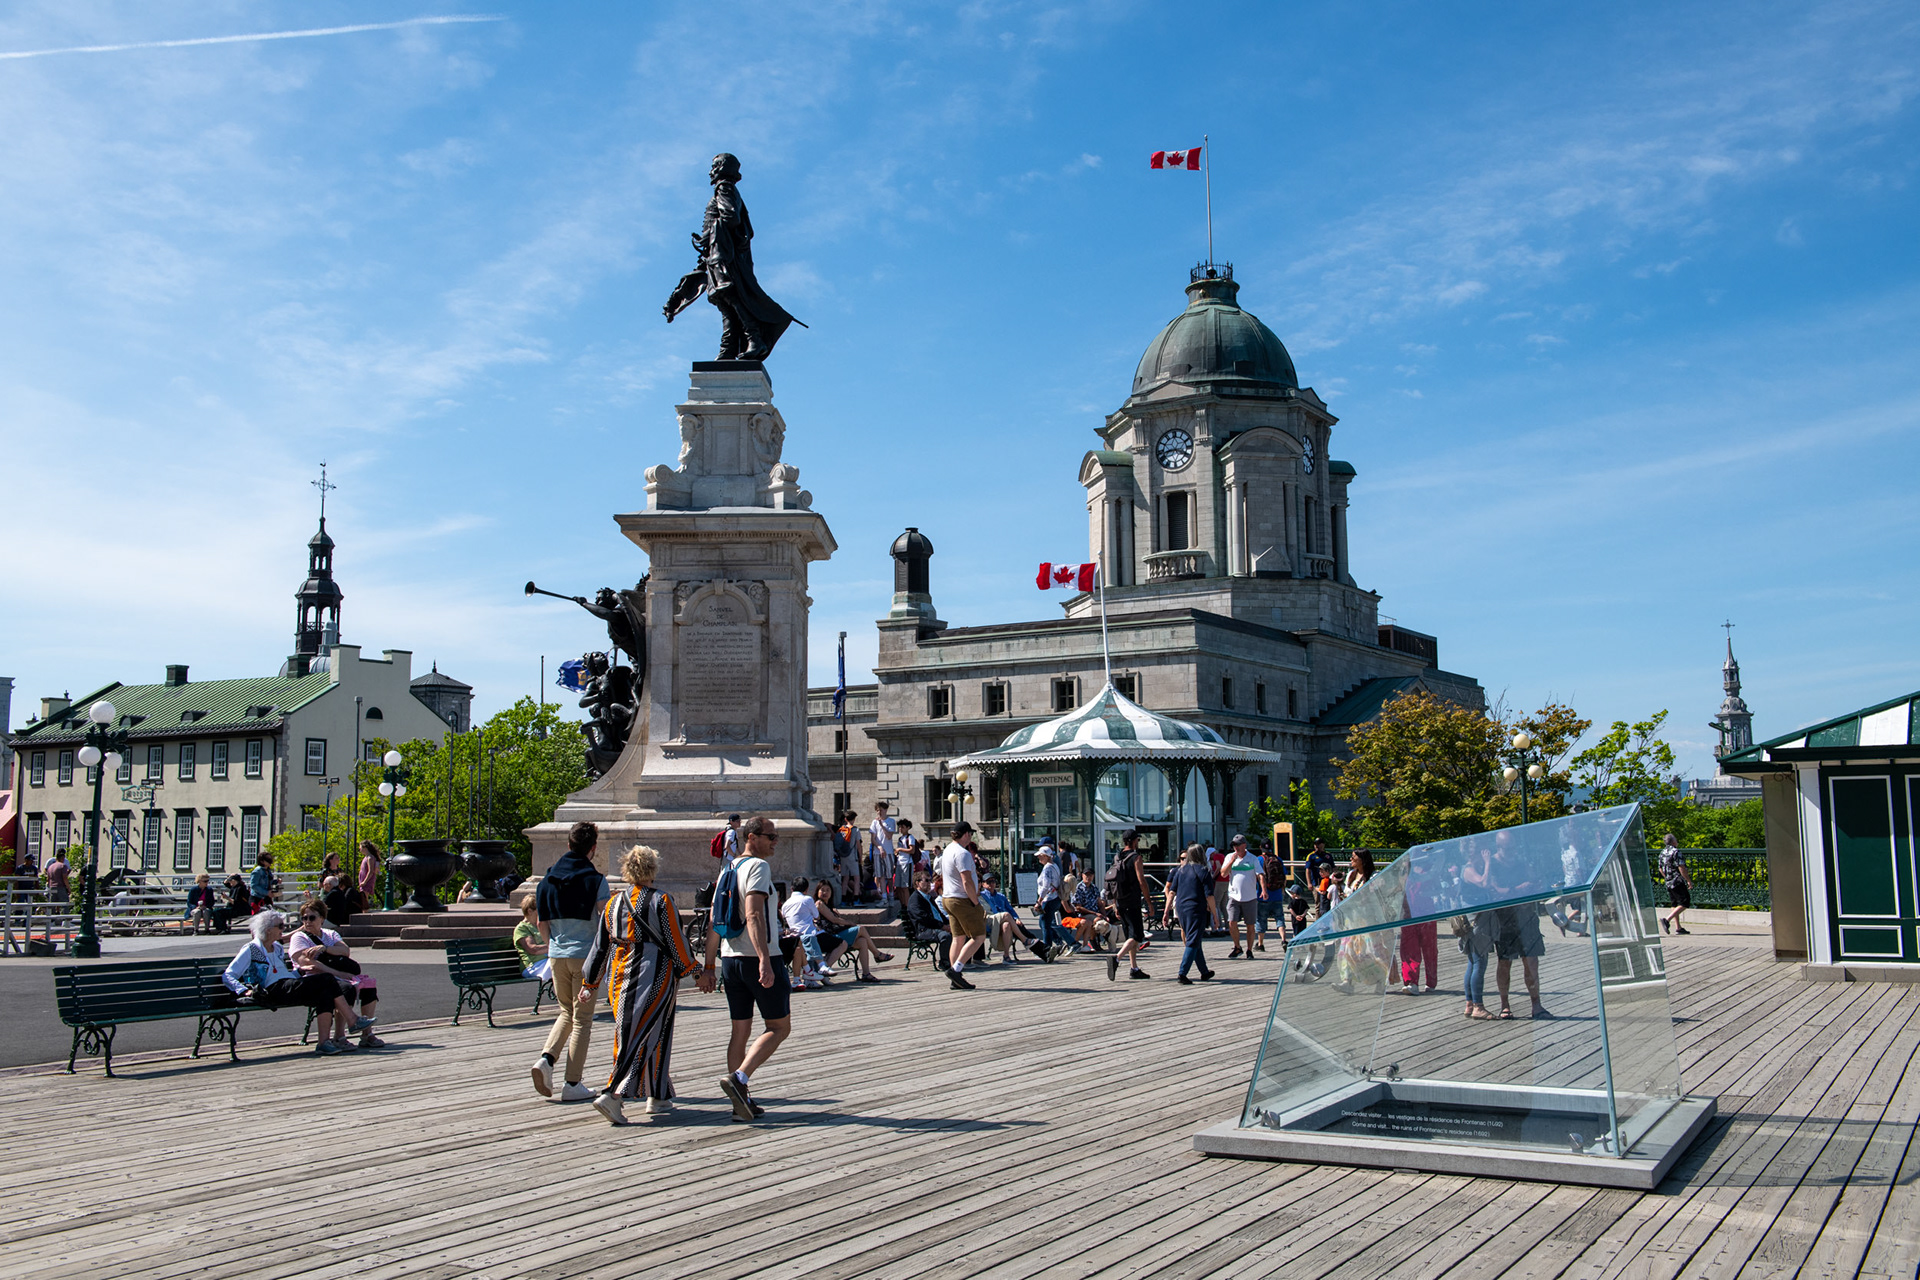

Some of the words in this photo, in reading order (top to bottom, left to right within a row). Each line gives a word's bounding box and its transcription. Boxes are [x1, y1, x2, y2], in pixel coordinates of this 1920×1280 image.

[1031, 775, 1072, 784] FRONTENAC
[1341, 1110, 1367, 1118] Descendez
[1396, 1114, 1415, 1122] vestiges
[1461, 1118, 1486, 1126] Frontenac
[1419, 1126, 1447, 1134] Frontenac's
[1449, 1128, 1473, 1136] residence
